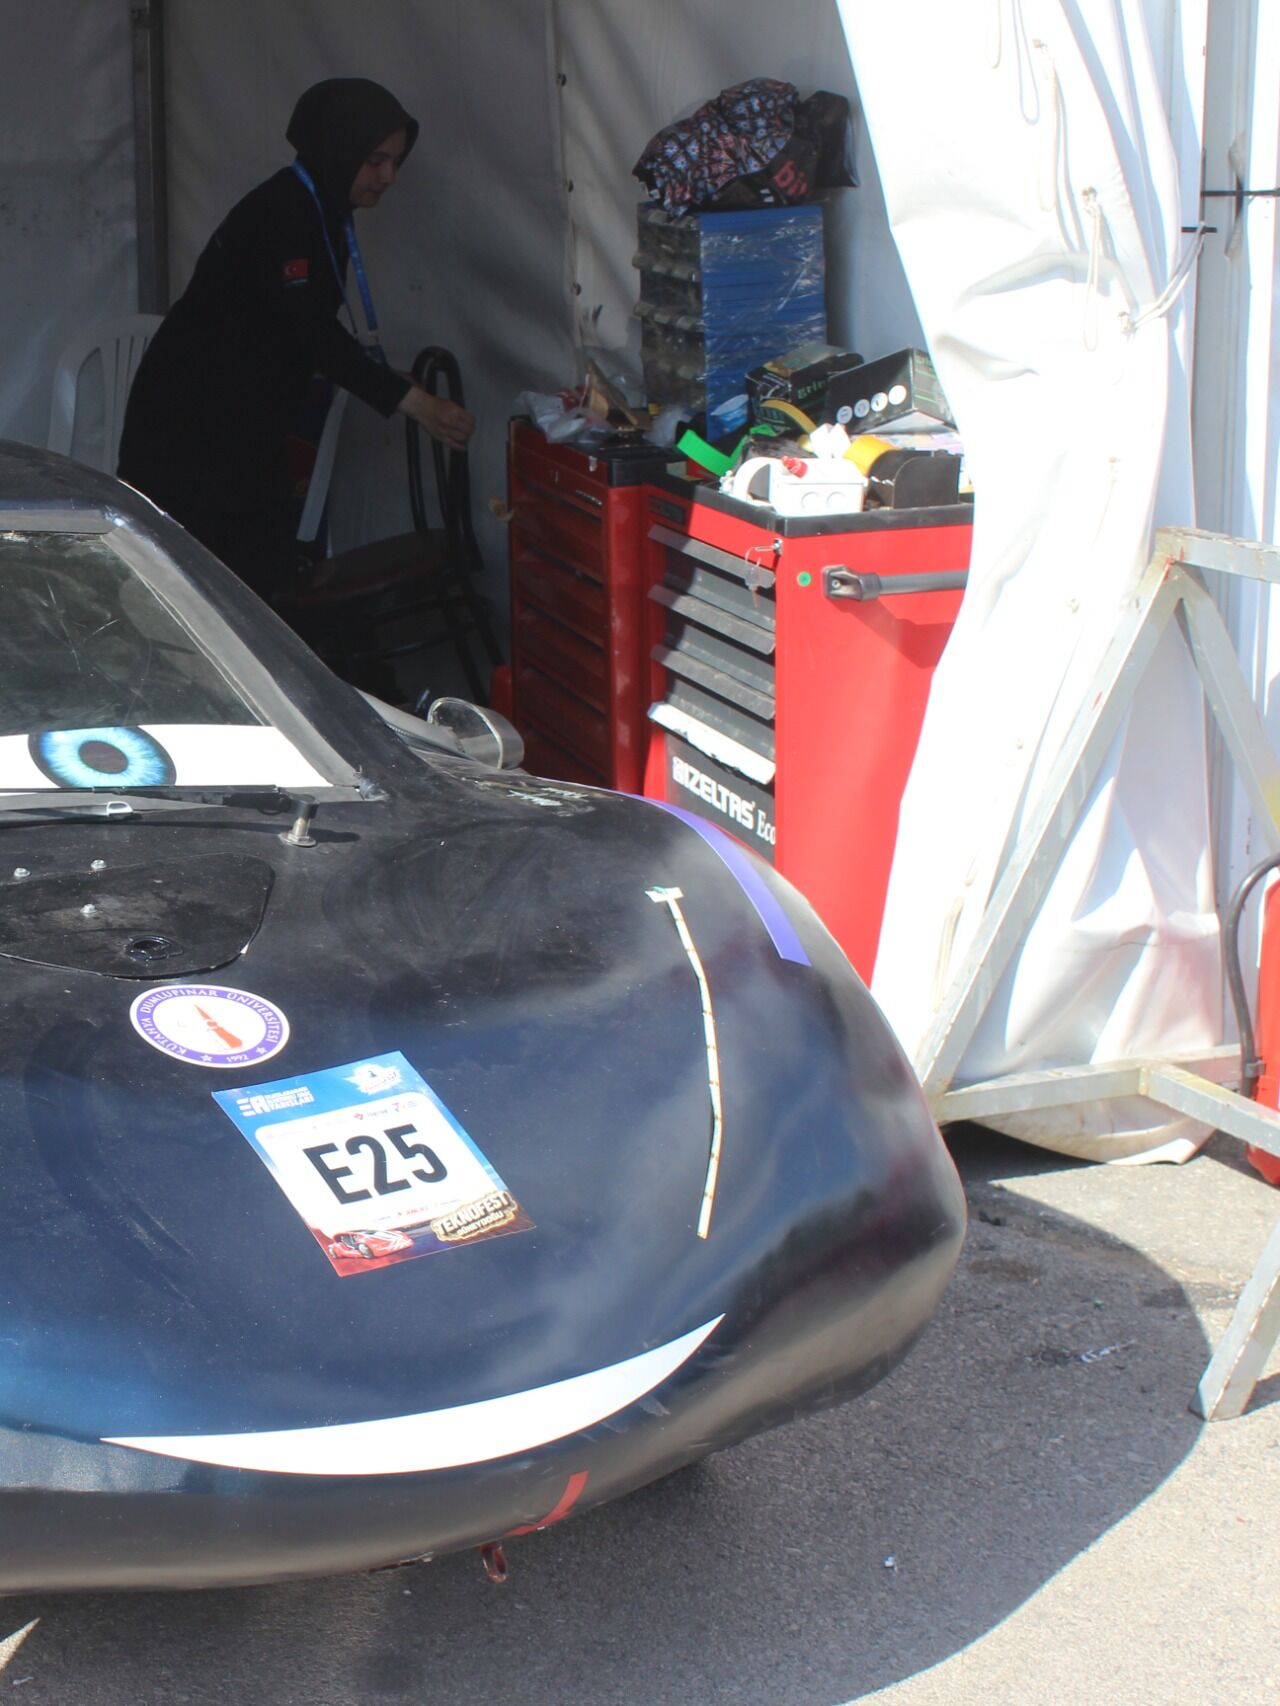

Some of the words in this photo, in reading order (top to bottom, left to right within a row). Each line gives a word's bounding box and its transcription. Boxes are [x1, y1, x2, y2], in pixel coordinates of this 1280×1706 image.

[139, 988, 219, 1014] DUMLUPINAR
[226, 1055, 250, 1063] 1992
[302, 1123, 448, 1205] E25
[433, 1190, 510, 1235] TEKNOFEST
